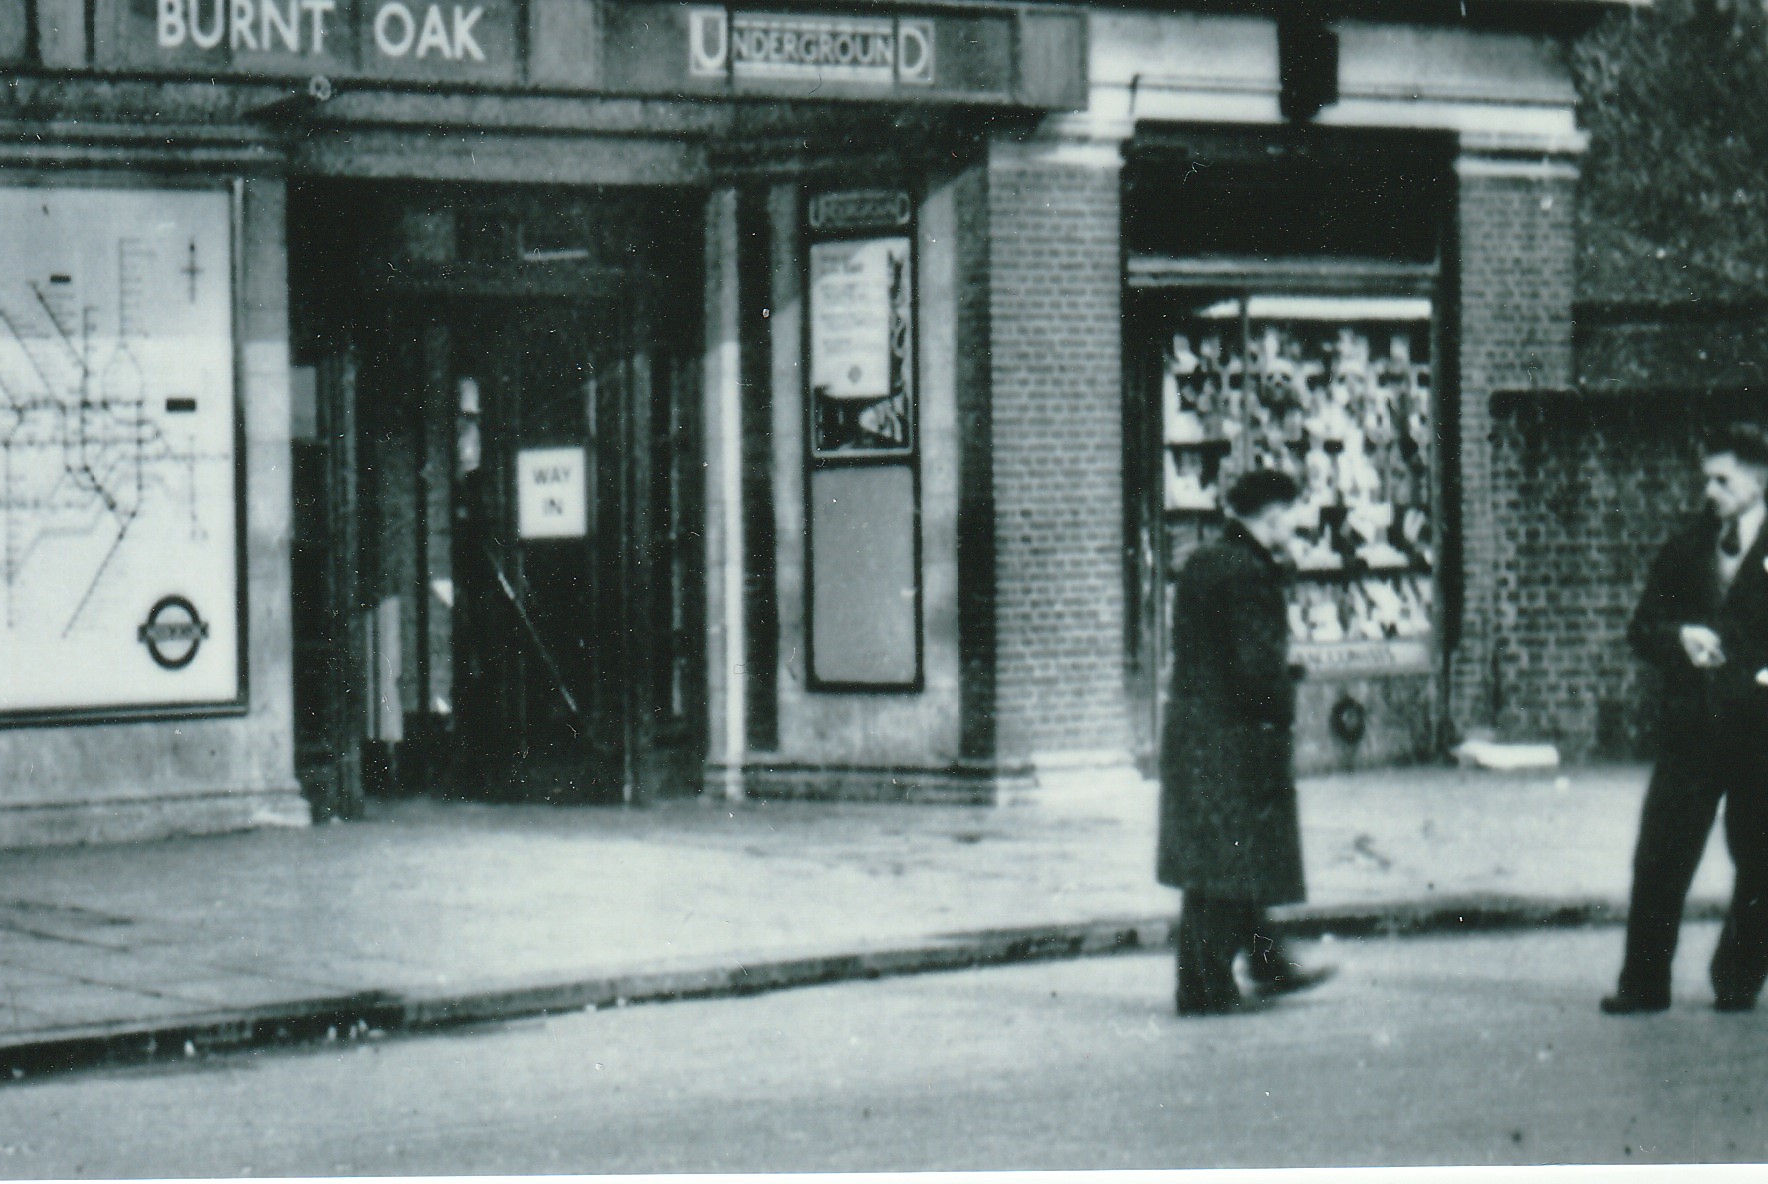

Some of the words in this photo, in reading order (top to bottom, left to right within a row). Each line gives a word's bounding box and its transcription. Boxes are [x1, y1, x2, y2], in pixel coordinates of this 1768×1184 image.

[374, 1, 487, 62] OAK
[692, 13, 929, 78] UNDERGROUND
[532, 466, 571, 485] WAY
[543, 497, 564, 515] IN
